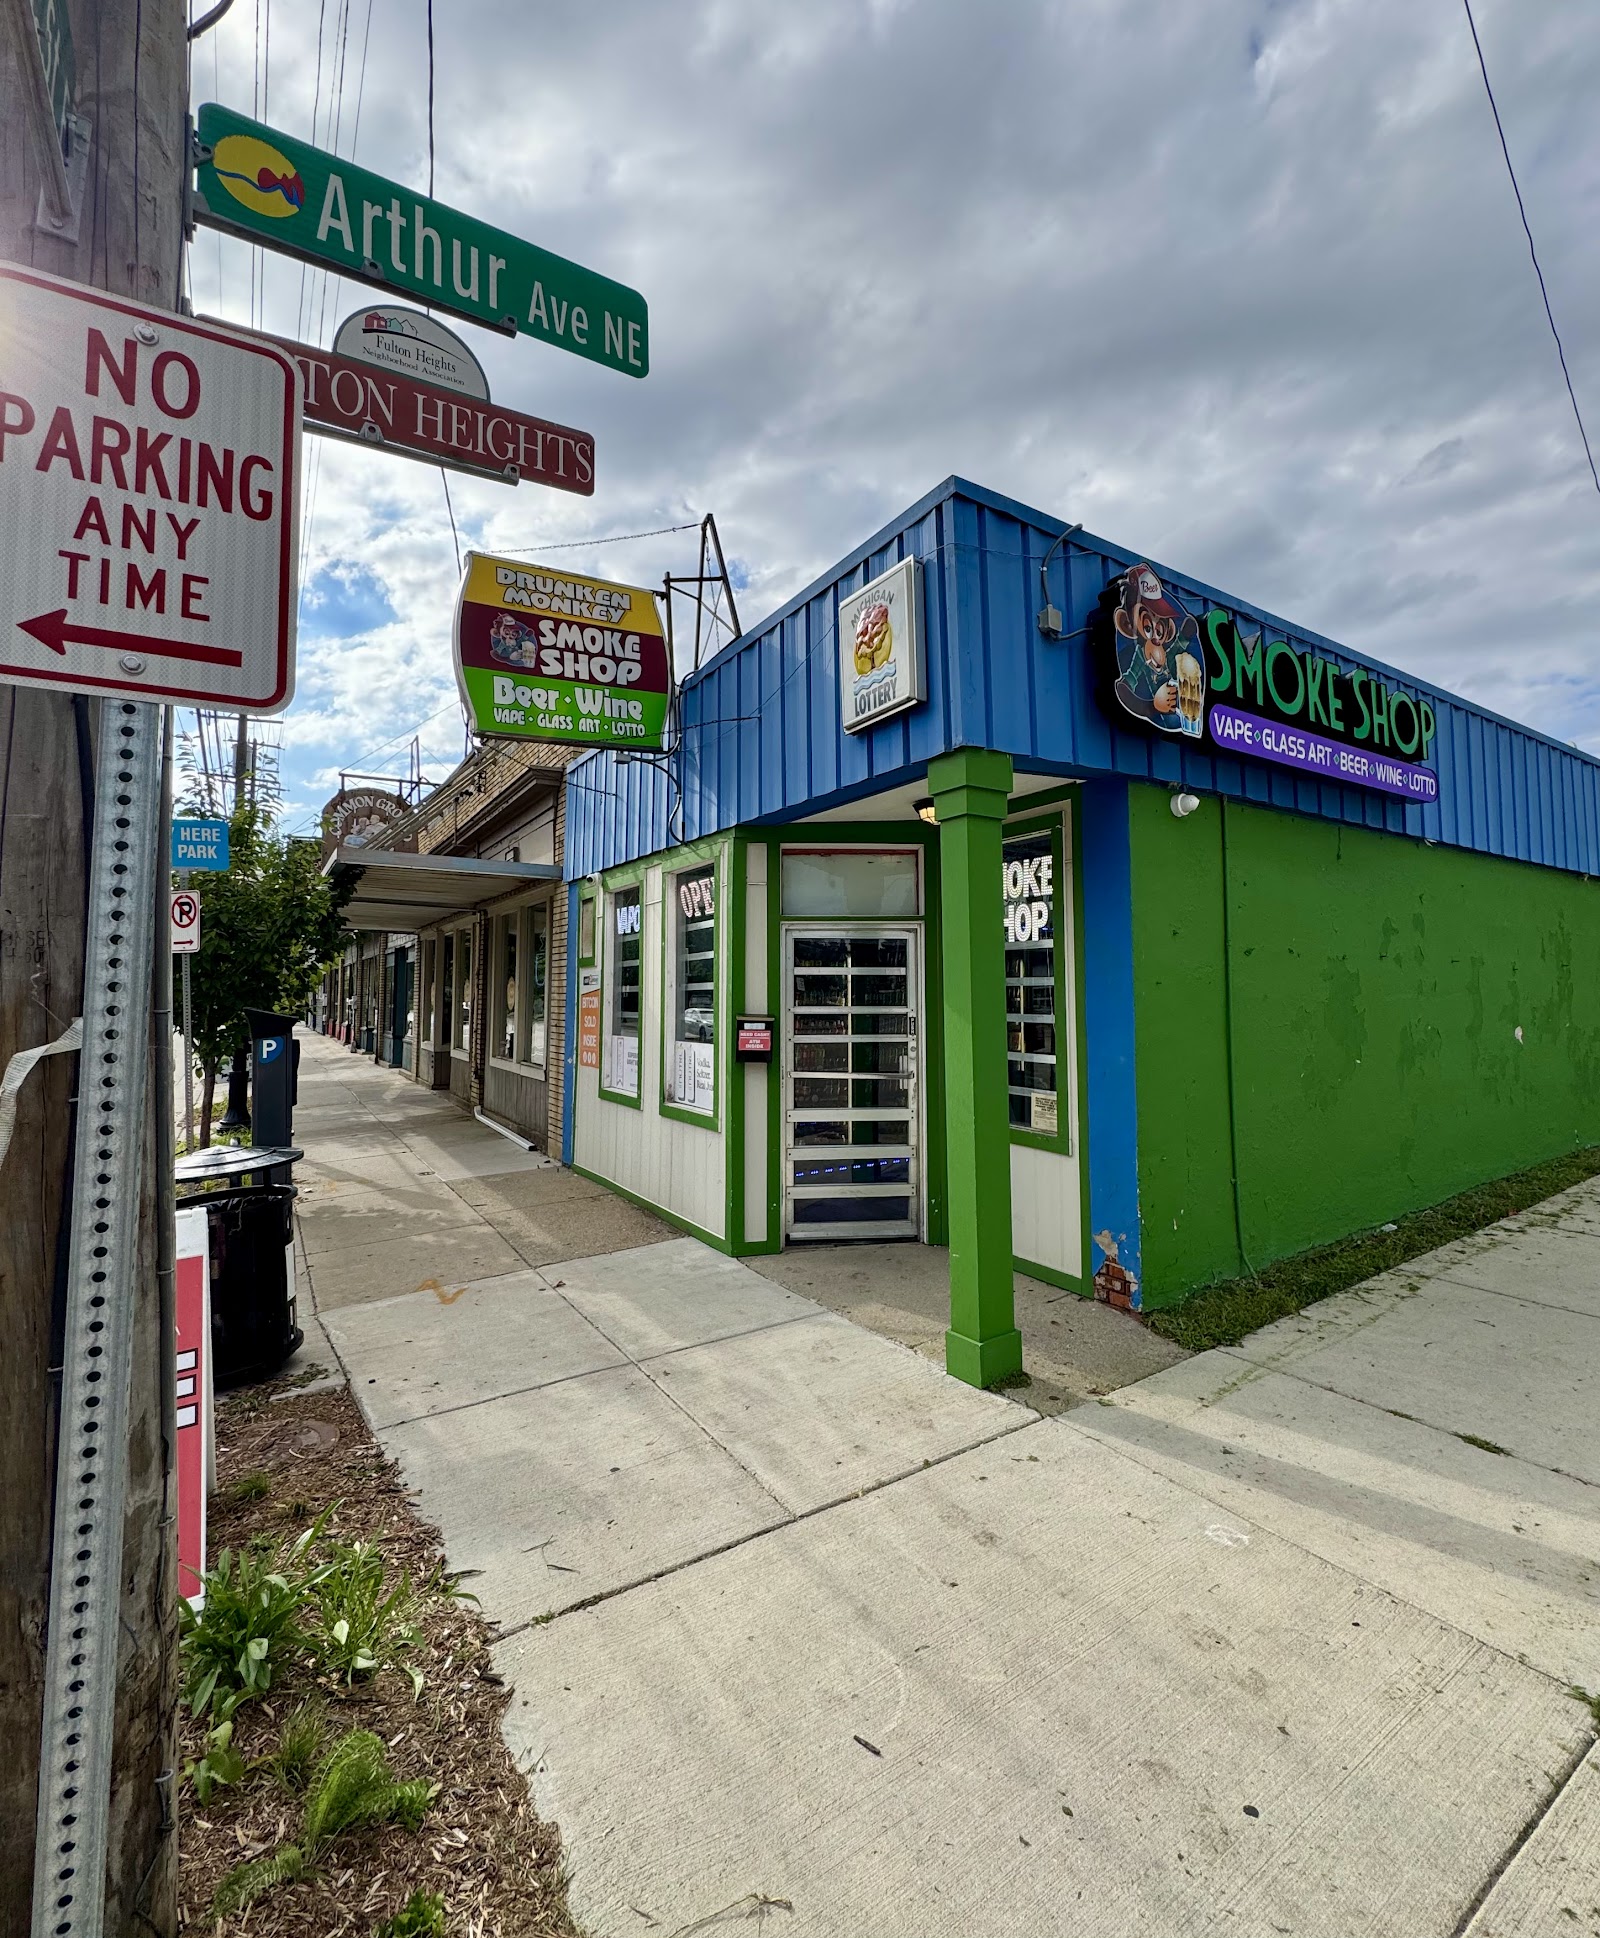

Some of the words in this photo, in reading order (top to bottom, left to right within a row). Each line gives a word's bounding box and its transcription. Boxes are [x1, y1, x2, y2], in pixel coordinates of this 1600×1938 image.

[317, 173, 506, 309] Arthur
[528, 281, 589, 345] Ave
[603, 310, 642, 368] NE
[85, 327, 200, 420] NO
[363, 346, 418, 371] Neighborhood
[422, 367, 465, 386] Association
[376, 335, 411, 358] Fulton
[416, 348, 456, 373] Heights
[0, 392, 273, 521] PARKING
[413, 392, 592, 483] HEIGHTS
[73, 496, 200, 560] ANY
[58, 550, 210, 622] TIME
[496, 566, 631, 610] DRUNKEN
[503, 586, 627, 624] MONKEY
[1141, 581, 1158, 592] Beer
[851, 589, 895, 628] MICHIGAN
[538, 619, 641, 660] SMOKE
[539, 649, 642, 685] SHOP
[1207, 608, 1345, 732] SMOKE
[1353, 668, 1436, 760] SHOP
[493, 676, 559, 710] Beer
[574, 686, 643, 721] Wine
[855, 677, 897, 717] LOTTERY
[493, 707, 525, 725] VAPE
[537, 712, 573, 730] GLASS
[578, 718, 601, 733] ART
[611, 721, 645, 736] LOTTO
[1213, 712, 1253, 745] VAPE
[1262, 728, 1305, 759] GLASS
[1308, 742, 1332, 767] ART
[1340, 752, 1368, 777] BEER
[1375, 762, 1402, 786] WINE
[1409, 772, 1435, 795] LOTTO
[181, 827, 221, 841] HERE
[329, 795, 374, 836] COMMON
[177, 844, 217, 859] PARK
[680, 877, 714, 918] OPE
[582, 996, 598, 1008] BITCOIN
[584, 1016, 596, 1027] SOLD
[262, 1039, 277, 1058] P
[583, 1035, 597, 1047] INSIDE
